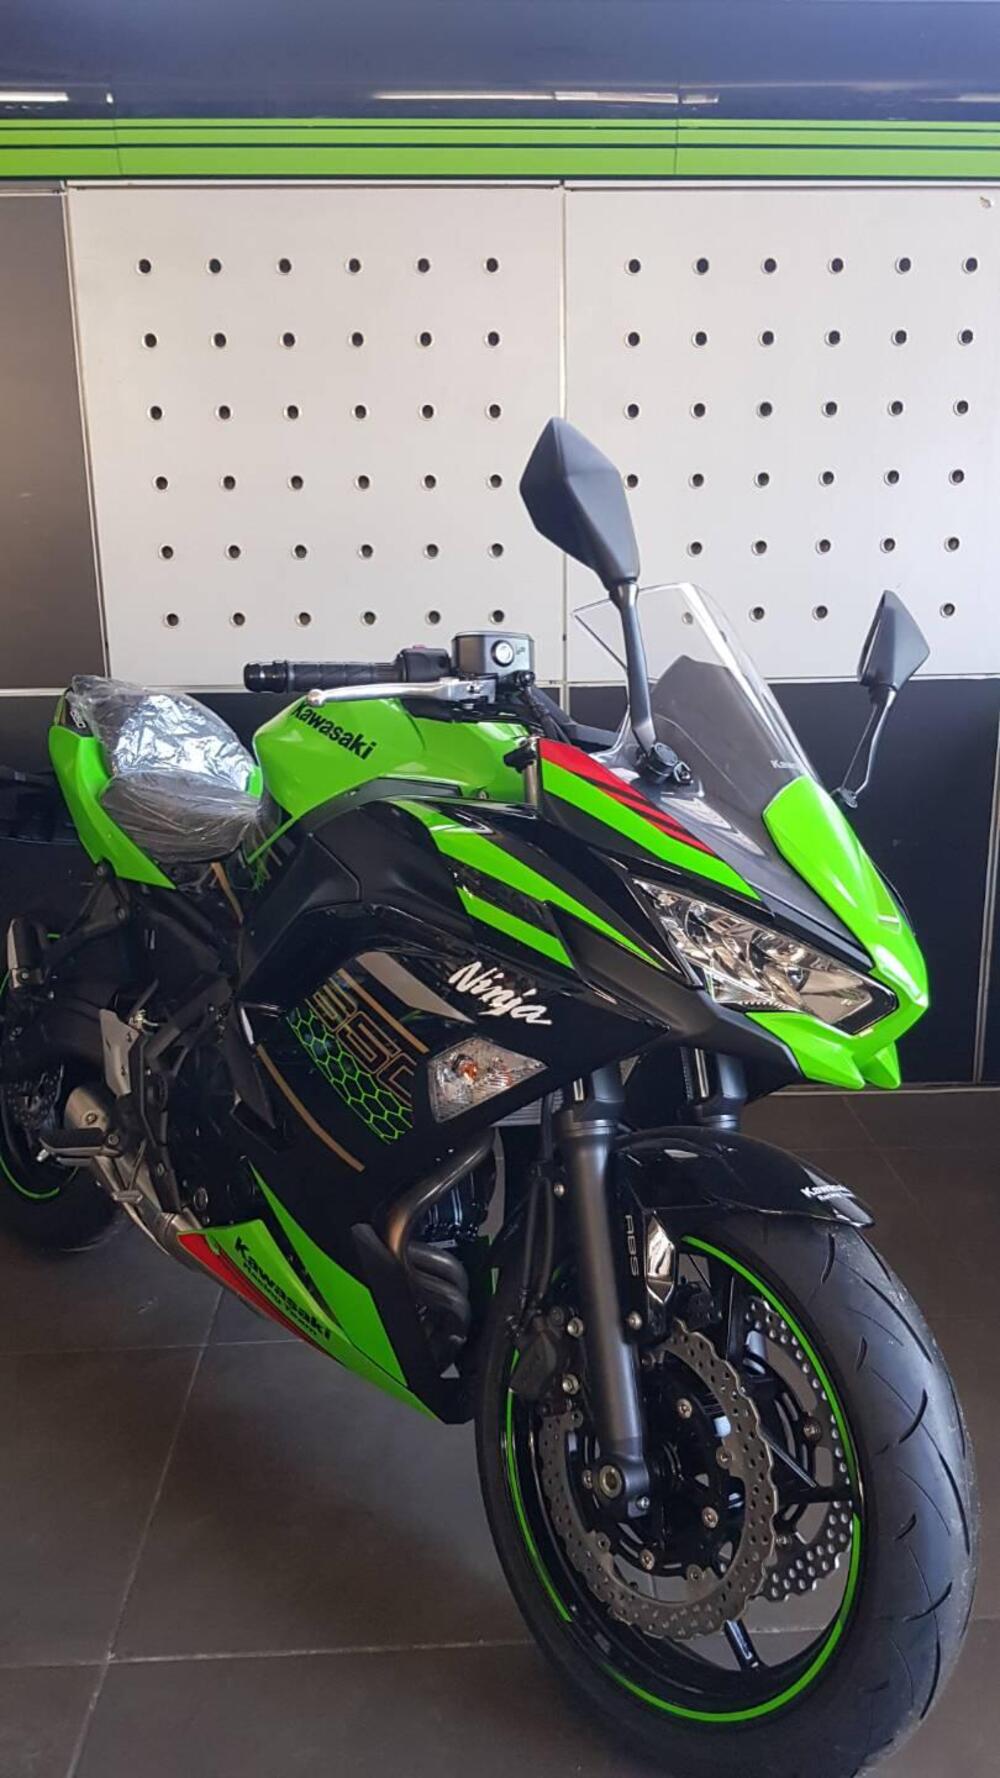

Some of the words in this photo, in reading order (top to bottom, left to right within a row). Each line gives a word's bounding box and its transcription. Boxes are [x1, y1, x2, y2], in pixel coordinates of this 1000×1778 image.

[290, 700, 378, 761] Kawasaki
[448, 961, 553, 1026] Ninja
[624, 1214, 640, 1277] ABS
